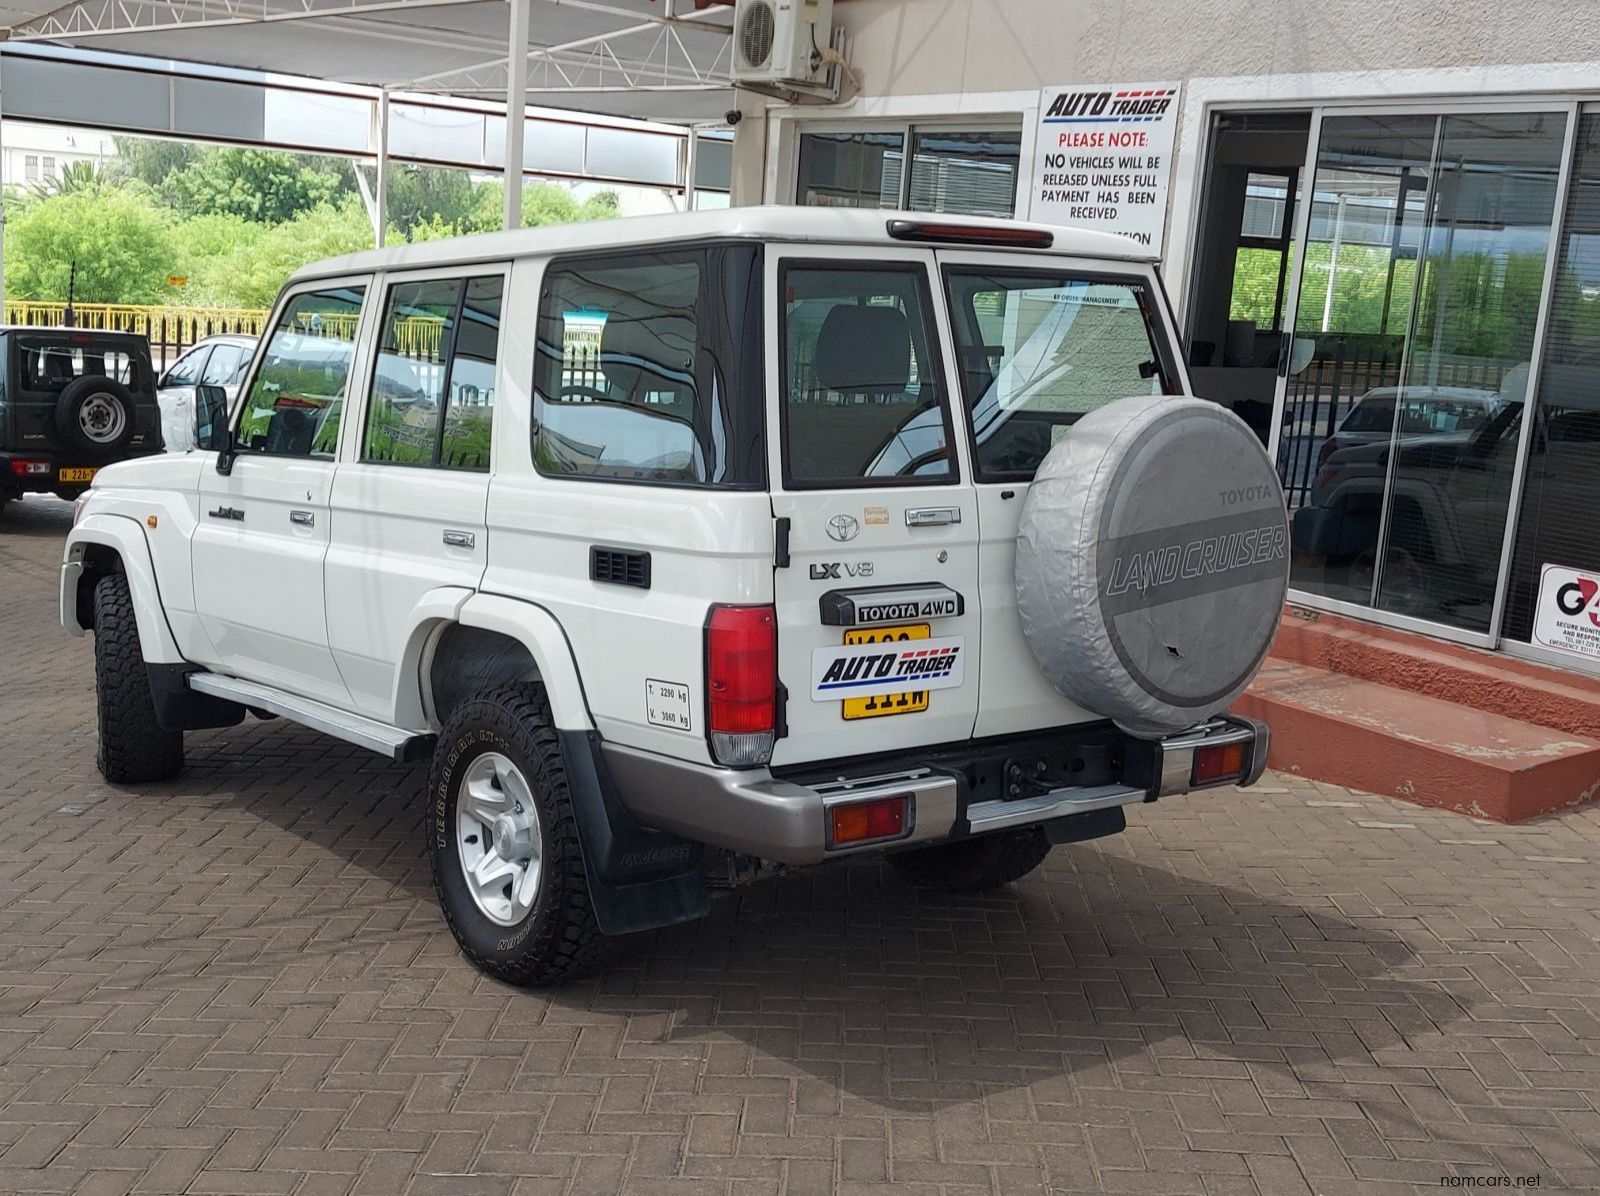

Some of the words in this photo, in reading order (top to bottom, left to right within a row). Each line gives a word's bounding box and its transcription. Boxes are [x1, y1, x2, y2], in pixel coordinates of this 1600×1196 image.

[1046, 92, 1112, 116] AUTO
[1109, 98, 1172, 116] TRADER
[1059, 132, 1104, 148] PLEASE
[1108, 132, 1149, 148] NOTE:
[1045, 154, 1065, 169] NO
[1069, 156, 1114, 169] VEHICLES
[1118, 157, 1142, 169] WILL
[1147, 157, 1160, 169] BE
[1043, 174, 1088, 186] RELEASED
[1092, 175, 1130, 187] UNLESS
[1133, 175, 1157, 187] FULL
[1042, 190, 1090, 202] PAYMENT
[1097, 192, 1120, 204] HAS
[1128, 192, 1156, 204] BEEN
[73, 470, 99, 480] 226-7
[1220, 485, 1272, 506] TOYOTA
[810, 563, 841, 580] LX
[844, 562, 874, 577] V8
[861, 604, 917, 621] TOYOTA
[921, 600, 955, 616] 4WD
[1556, 621, 1578, 630] SECURE
[1576, 632, 1600, 642] RESPON
[821, 654, 898, 683] AUTO
[896, 655, 957, 675] TRADER
[660, 688, 674, 698] 2290
